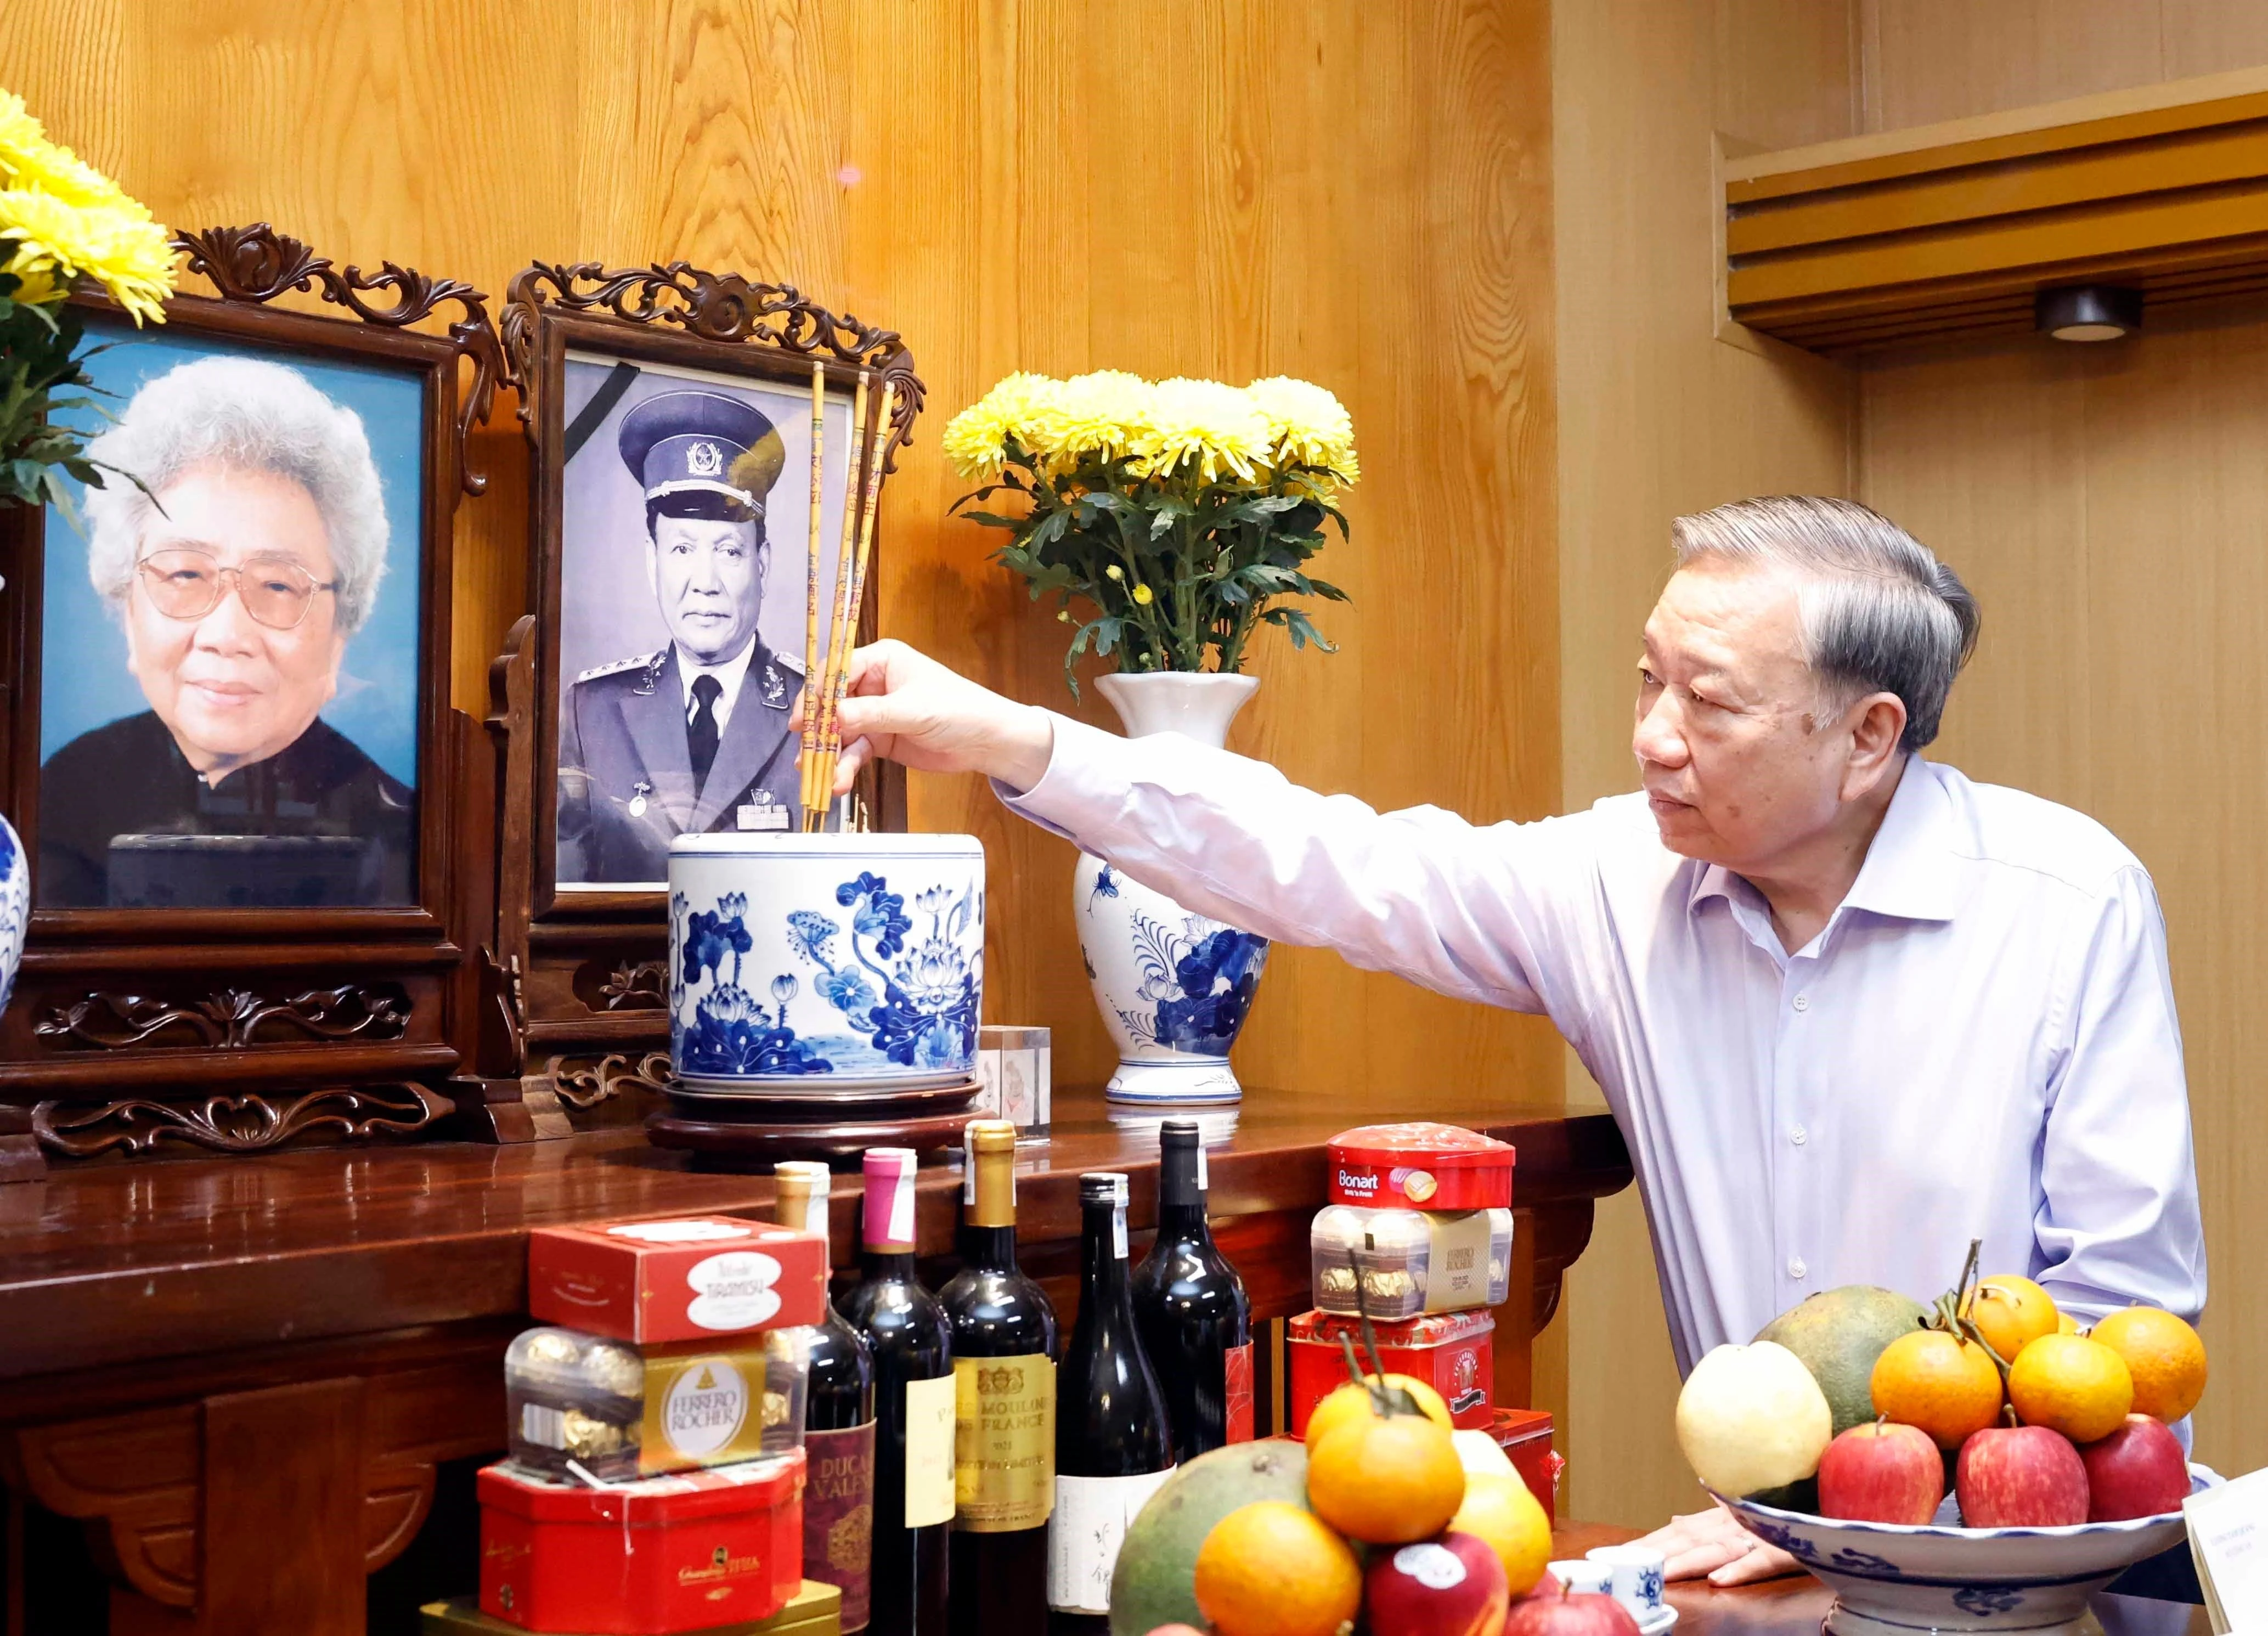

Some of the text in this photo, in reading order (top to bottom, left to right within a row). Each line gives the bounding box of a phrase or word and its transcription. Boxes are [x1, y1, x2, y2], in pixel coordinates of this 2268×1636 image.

[1339, 1170, 1378, 1189] Bonart
[673, 1389, 737, 1413] FERRERO
[672, 1407, 735, 1431] ROCHER
[981, 1414, 1045, 1431] FRANCE
